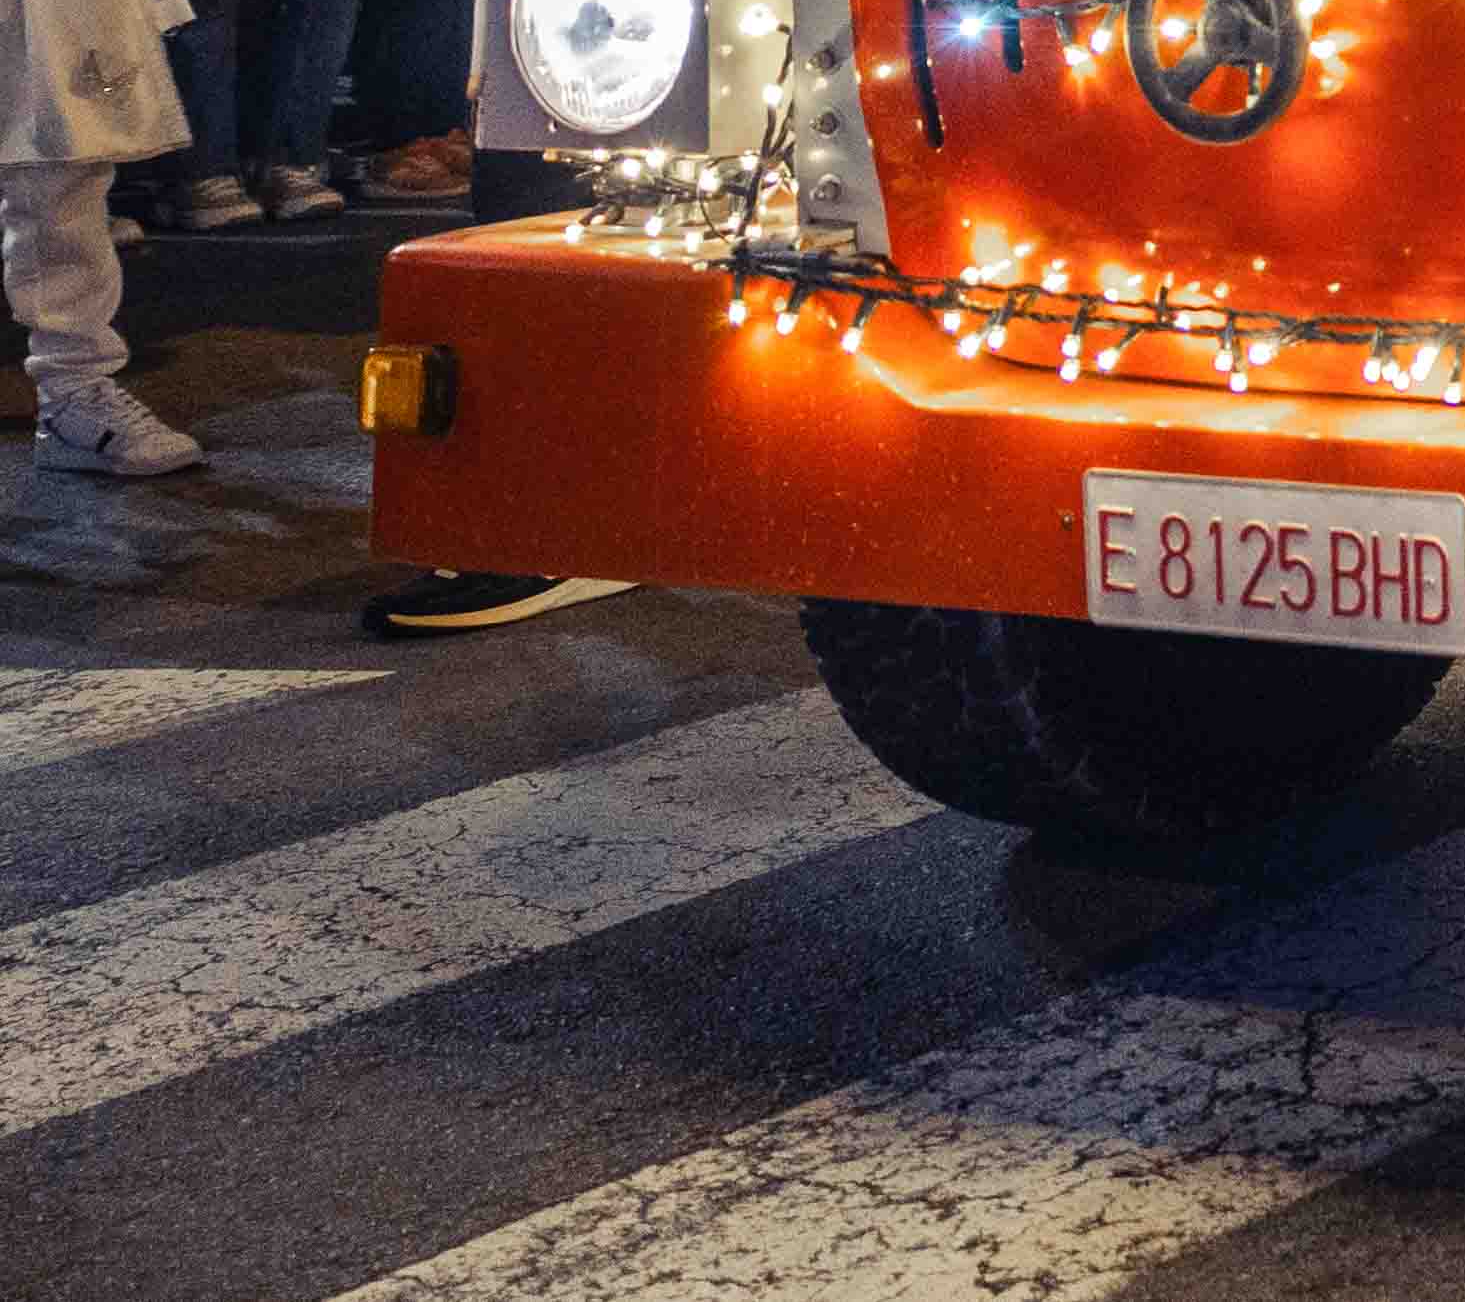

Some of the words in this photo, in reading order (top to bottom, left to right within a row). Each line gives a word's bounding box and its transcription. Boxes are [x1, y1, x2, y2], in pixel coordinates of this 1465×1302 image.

[1097, 506, 1137, 594] E
[1158, 513, 1317, 613] 8125
[1328, 526, 1451, 626] BHD
